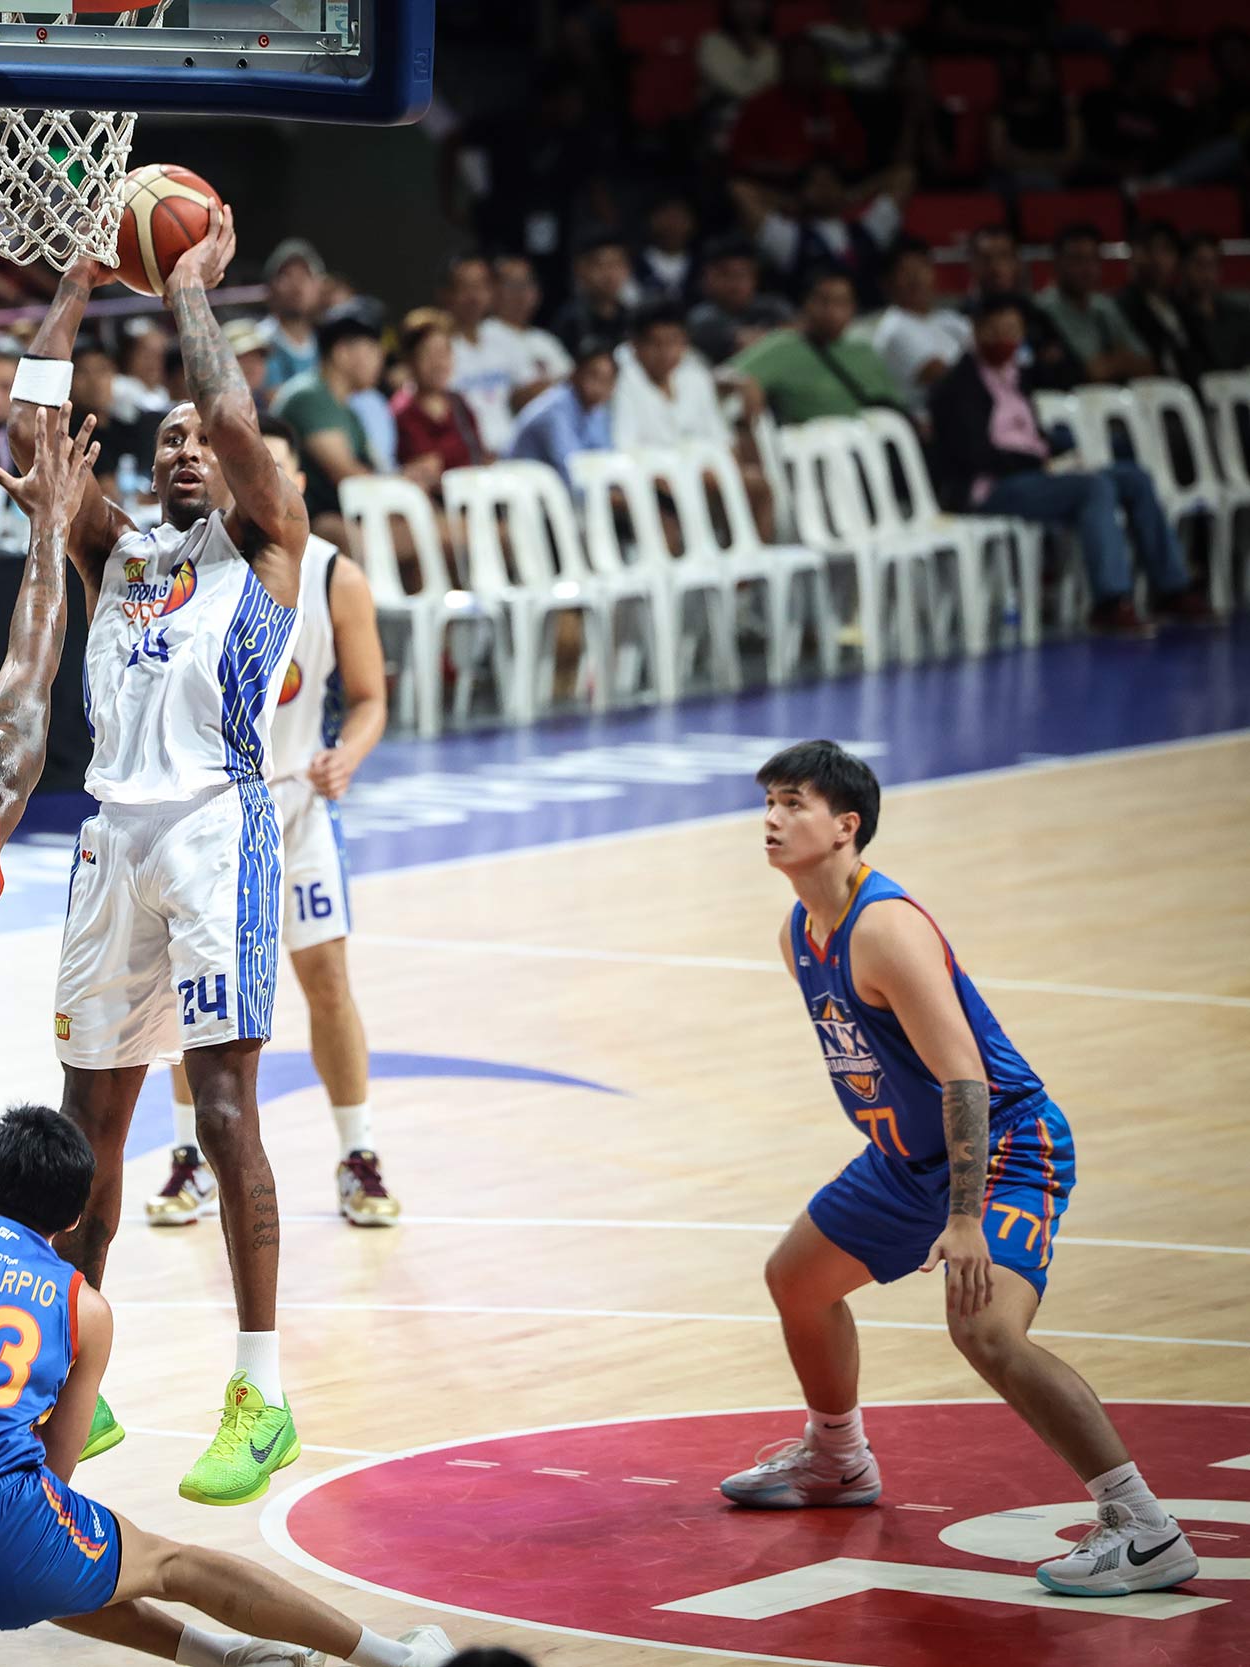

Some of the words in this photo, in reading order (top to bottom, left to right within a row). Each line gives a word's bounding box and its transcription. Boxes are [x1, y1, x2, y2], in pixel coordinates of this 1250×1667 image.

[293, 882, 333, 921] 16
[178, 973, 228, 1026] 24
[854, 1106, 911, 1157] 77
[990, 1202, 1042, 1252] 77
